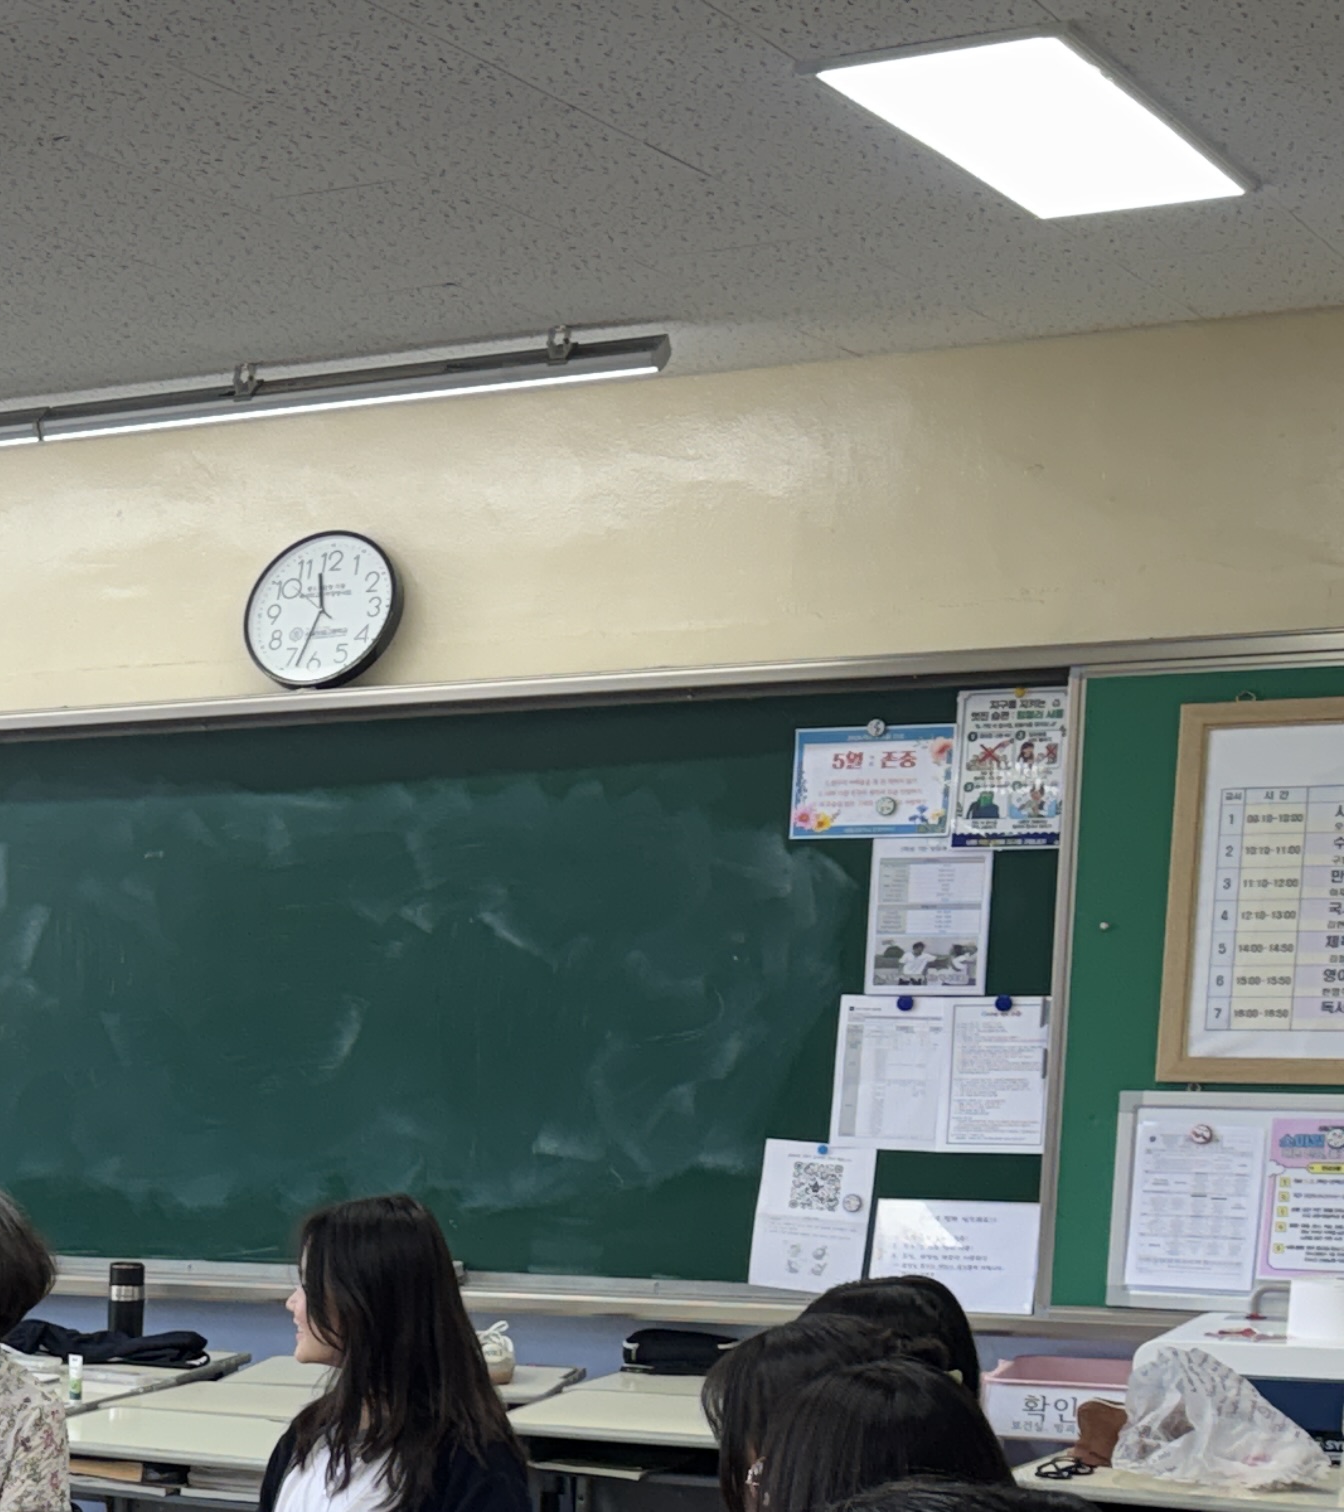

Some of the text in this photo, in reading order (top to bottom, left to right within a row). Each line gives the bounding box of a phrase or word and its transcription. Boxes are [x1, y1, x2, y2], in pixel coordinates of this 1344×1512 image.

[297, 559, 313, 580] 11
[321, 550, 344, 572] 12
[353, 554, 361, 575] 1
[271, 577, 303, 600] 10
[364, 571, 381, 593] 2
[266, 603, 282, 626] 9
[366, 596, 382, 618] 3
[268, 629, 283, 651] 8
[353, 624, 370, 644] 4
[286, 647, 299, 667] 7
[306, 651, 322, 672] 6
[333, 643, 349, 664] 5
[831, 751, 863, 770] 5월
[880, 750, 917, 769] 존중
[1228, 813, 1234, 825] 1
[1225, 845, 1233, 857] 2
[1222, 878, 1231, 890] 3
[1221, 910, 1229, 921] 4
[1218, 943, 1226, 955] 5
[1216, 975, 1224, 987] 6
[1214, 1007, 1222, 1019] 7
[1021, 1394, 1078, 1423] 확인
